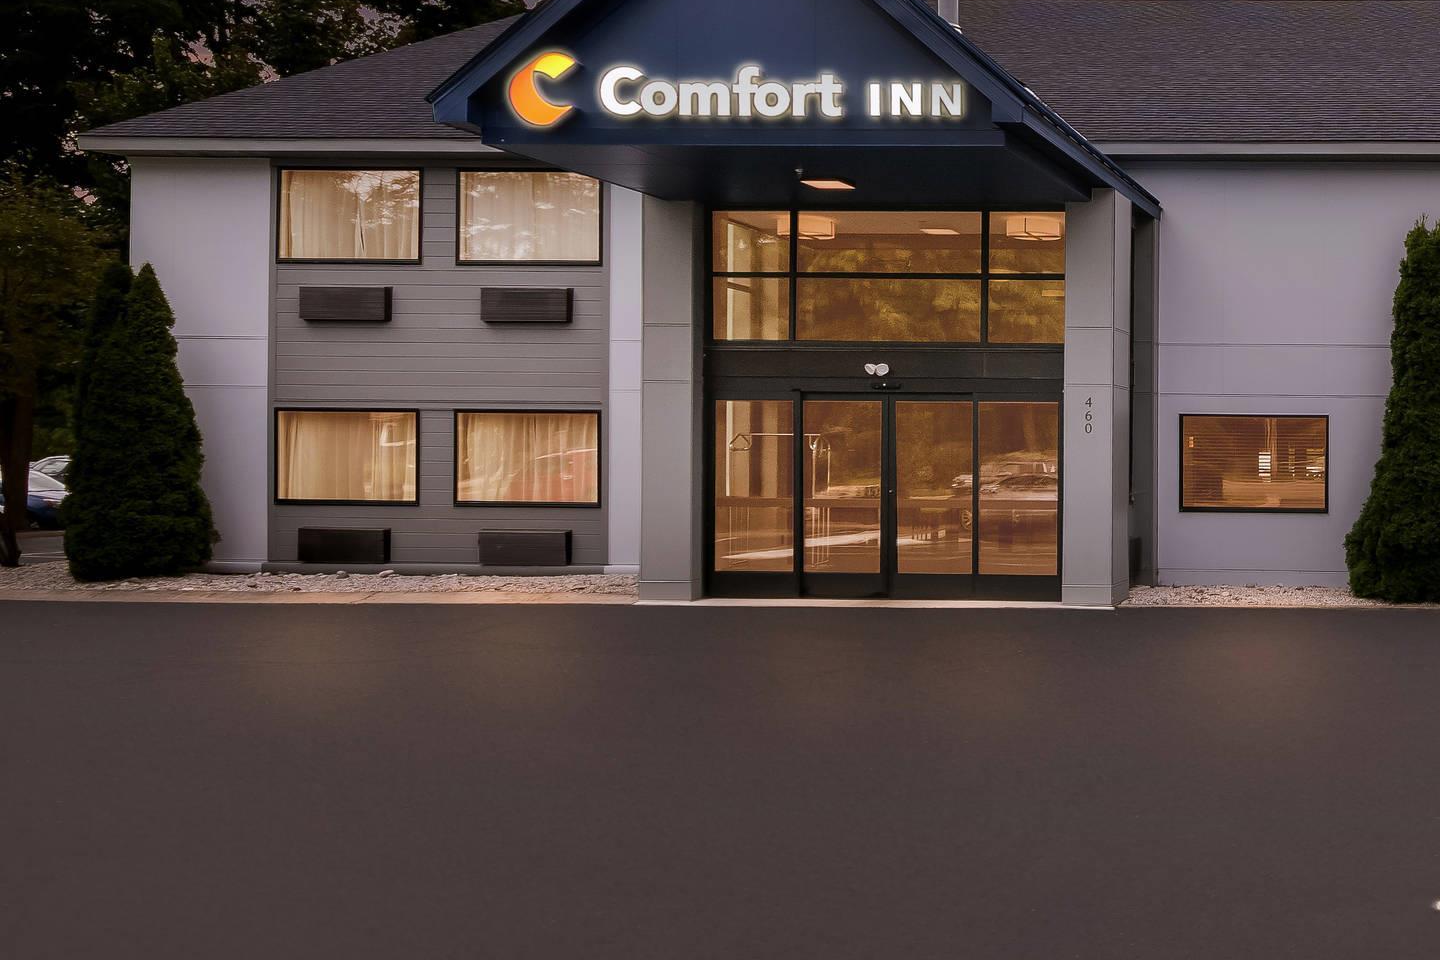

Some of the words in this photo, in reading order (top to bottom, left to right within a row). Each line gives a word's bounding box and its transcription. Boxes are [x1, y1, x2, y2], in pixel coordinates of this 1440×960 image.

[600, 65, 843, 117] Comfort
[869, 82, 963, 117] INN
[1084, 396, 1093, 434] 460
